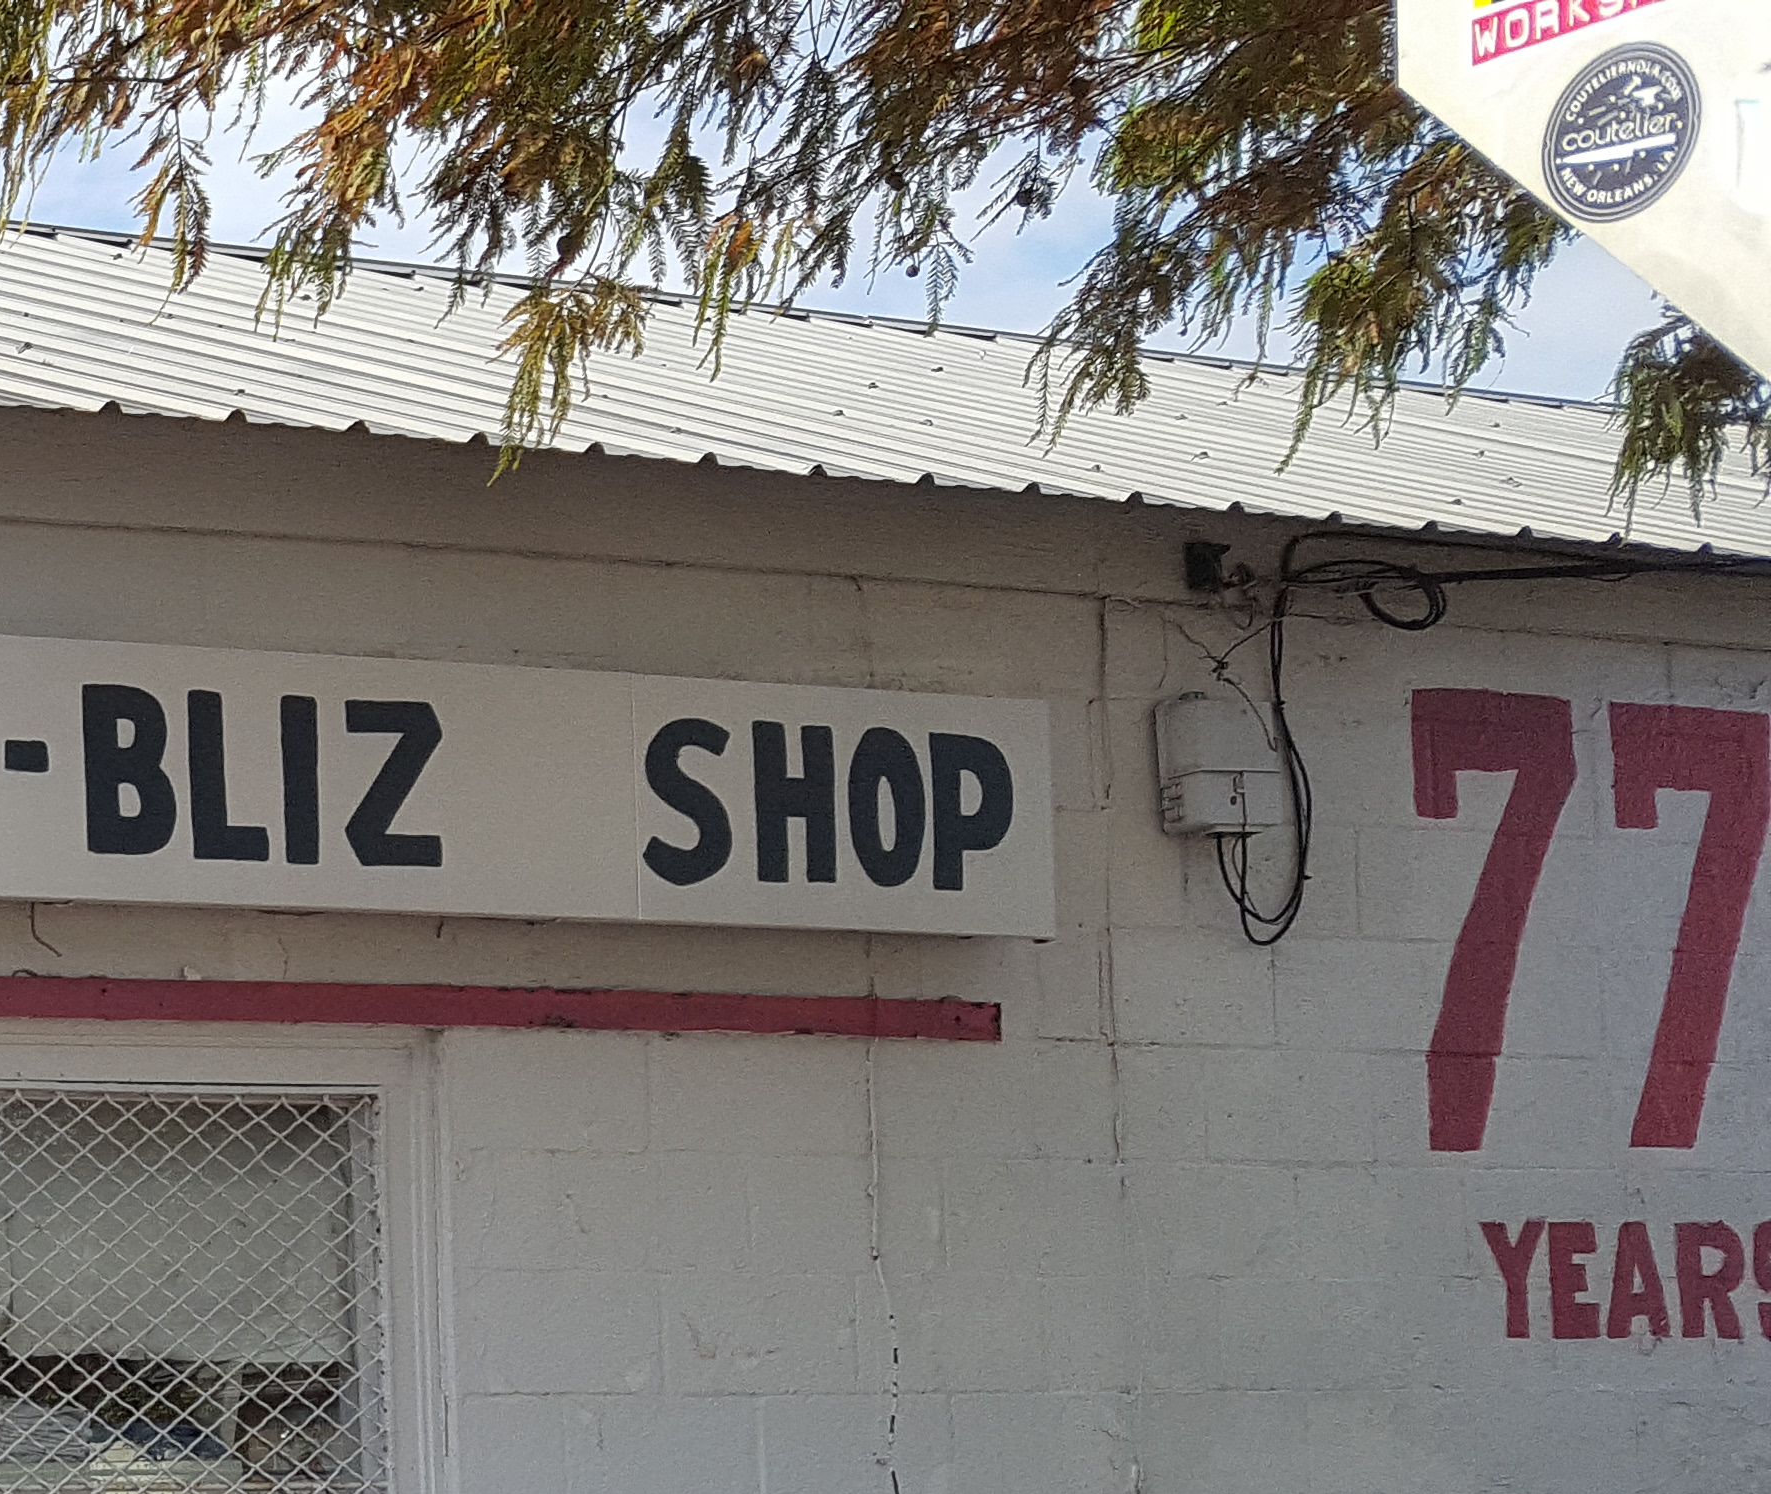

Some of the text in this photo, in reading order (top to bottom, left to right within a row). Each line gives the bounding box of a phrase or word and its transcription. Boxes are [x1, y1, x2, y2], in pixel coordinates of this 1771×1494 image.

[1473, 0, 1639, 58] WORKS
[1561, 111, 1677, 151] coutelier
[1561, 166, 1588, 197] NEW
[642, 717, 1016, 892] SHOP
[1411, 687, 1771, 1152] 77
